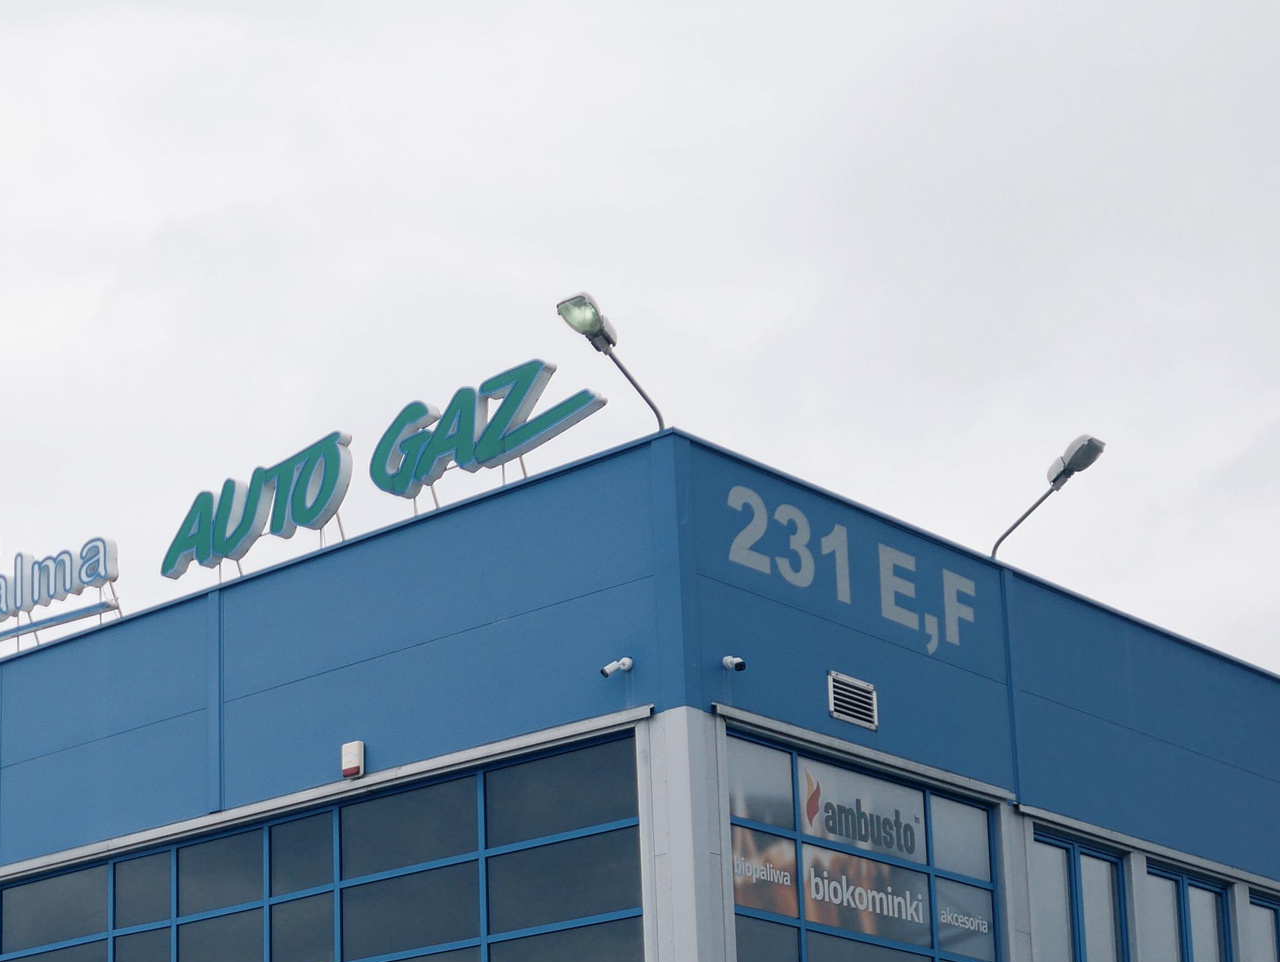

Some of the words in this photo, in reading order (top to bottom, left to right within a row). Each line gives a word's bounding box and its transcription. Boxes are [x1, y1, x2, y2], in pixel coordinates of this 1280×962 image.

[161, 431, 348, 578] AUTO
[369, 359, 604, 498] GAZ
[727, 485, 851, 605] 231
[878, 543, 976, 655] E,F
[824, 798, 916, 855] ambusto
[734, 856, 791, 887] biopaliwa
[810, 868, 924, 924] biokominki
[941, 908, 989, 934] akcesoria
